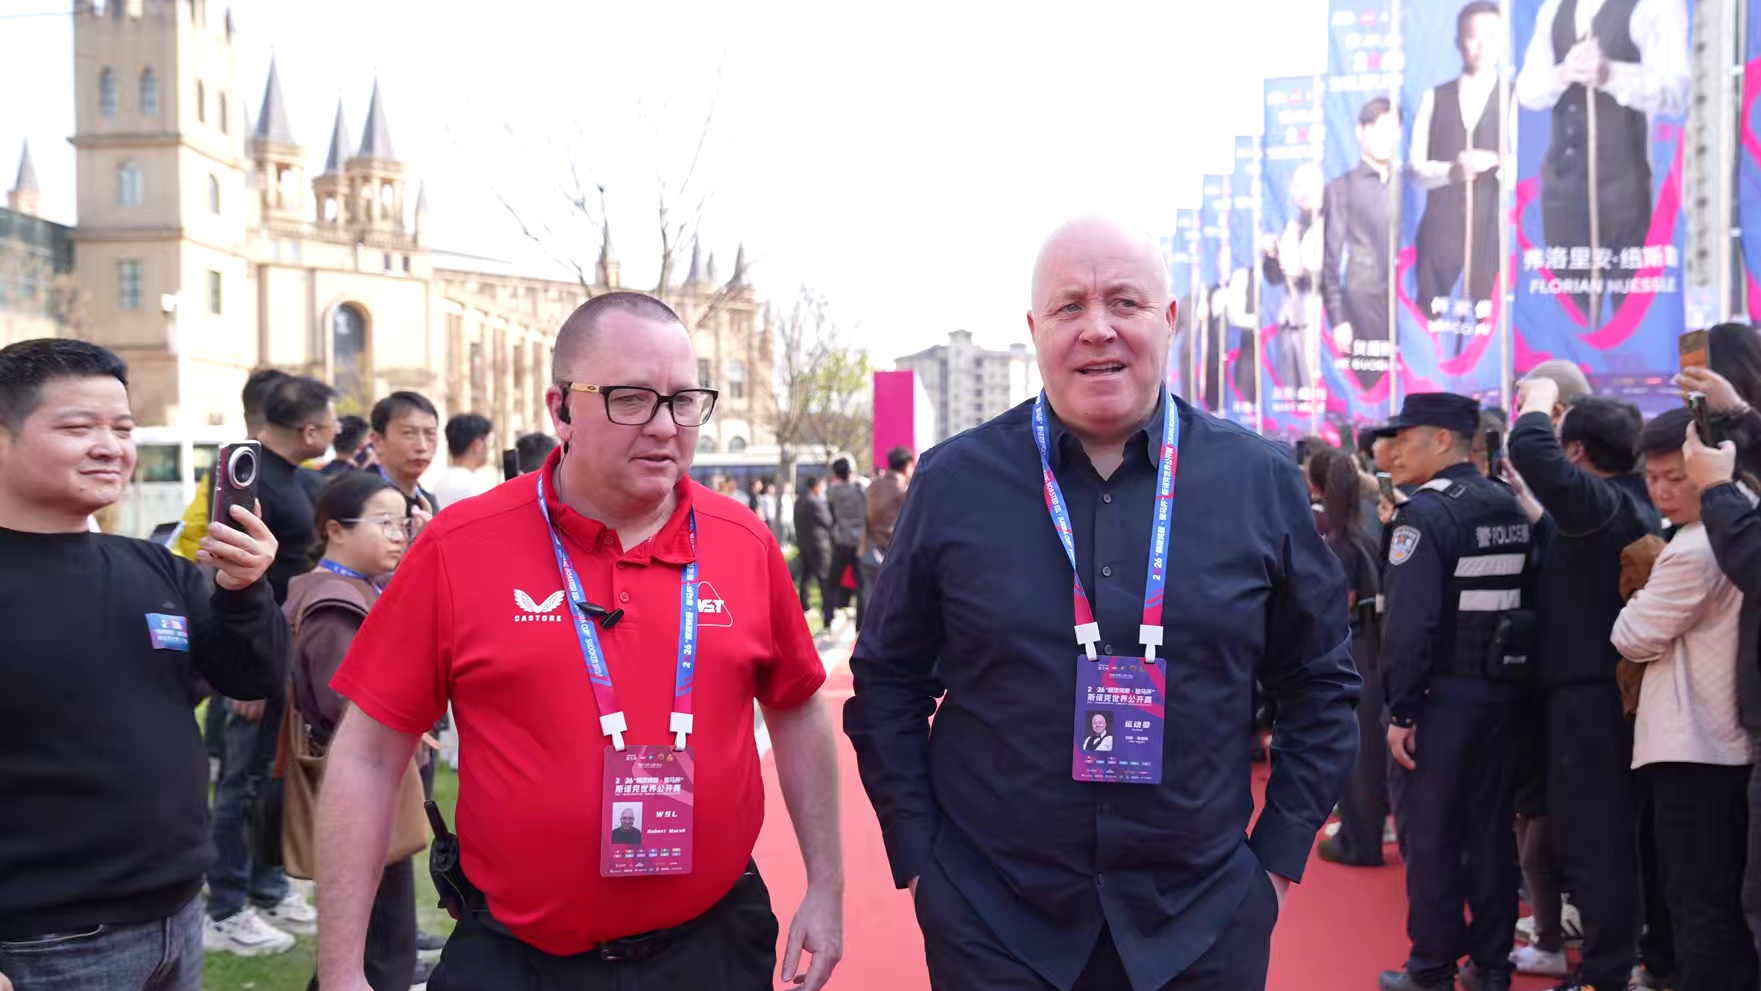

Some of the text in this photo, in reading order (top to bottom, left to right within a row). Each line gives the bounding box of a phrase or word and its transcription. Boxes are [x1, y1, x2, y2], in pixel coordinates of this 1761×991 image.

[1529, 278, 1603, 295] FLORIAN
[514, 615, 562, 623] CASTORE
[1087, 694, 1153, 703] 斯诺克世界公开赛
[615, 784, 681, 793] 斯诺克世界公开赛
[656, 810, 678, 818] WSL
